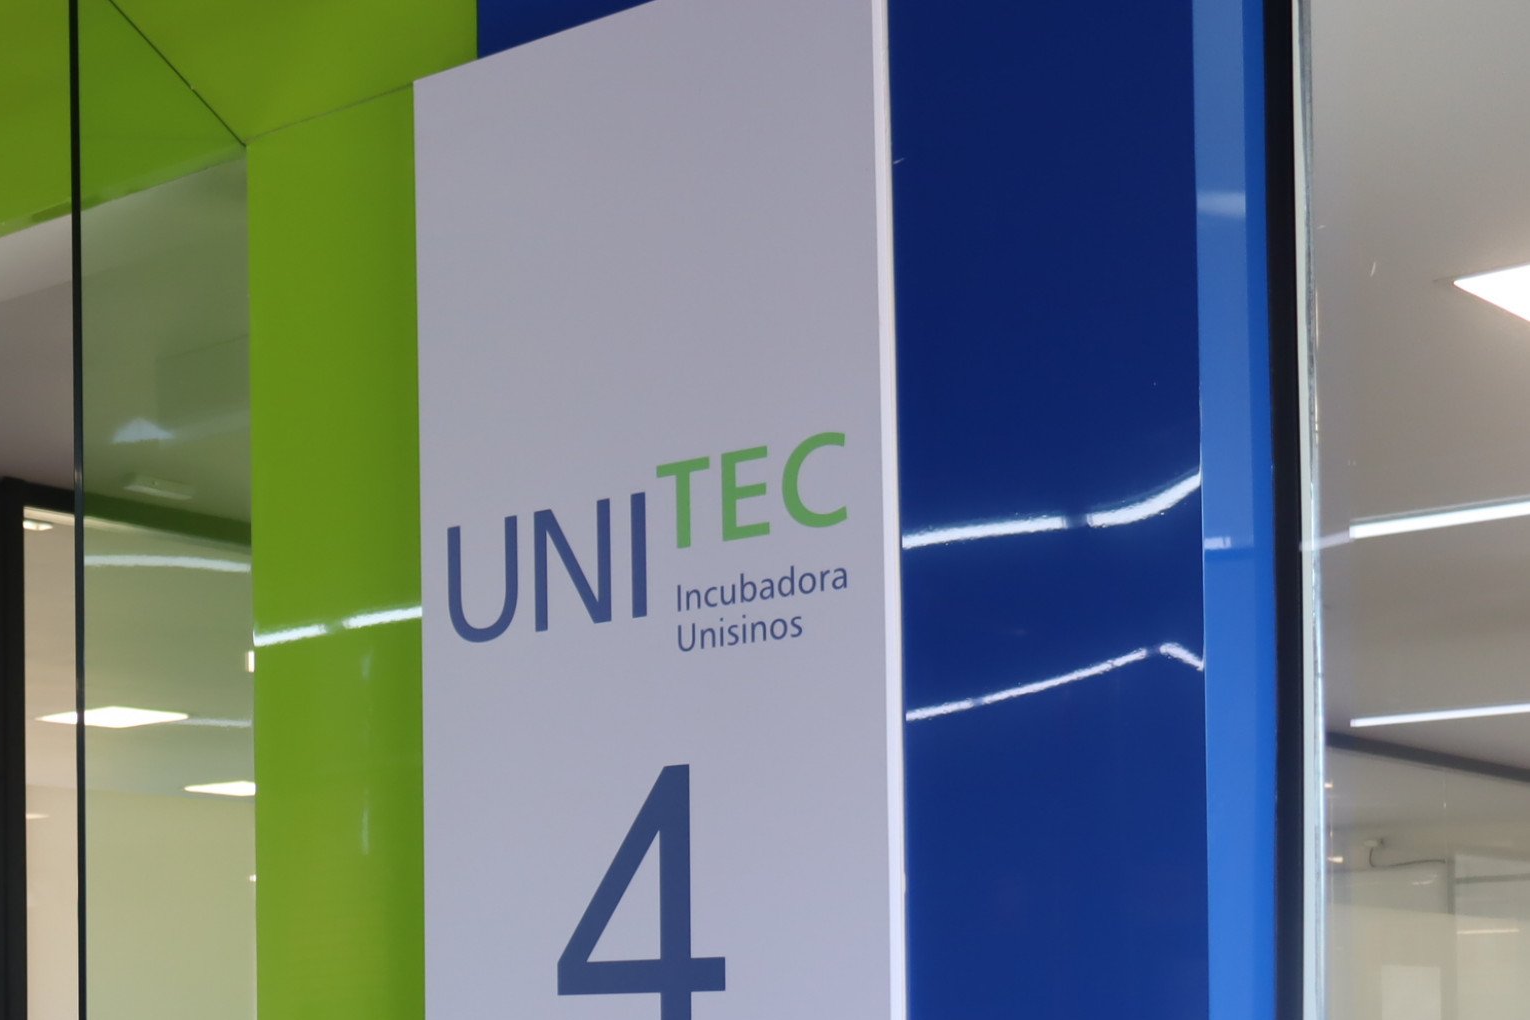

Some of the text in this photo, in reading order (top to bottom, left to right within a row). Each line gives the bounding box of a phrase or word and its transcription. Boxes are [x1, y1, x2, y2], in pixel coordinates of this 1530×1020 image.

[447, 431, 848, 643] UNITEC
[676, 565, 848, 612] Incubadora
[676, 615, 804, 652] Unisinos
